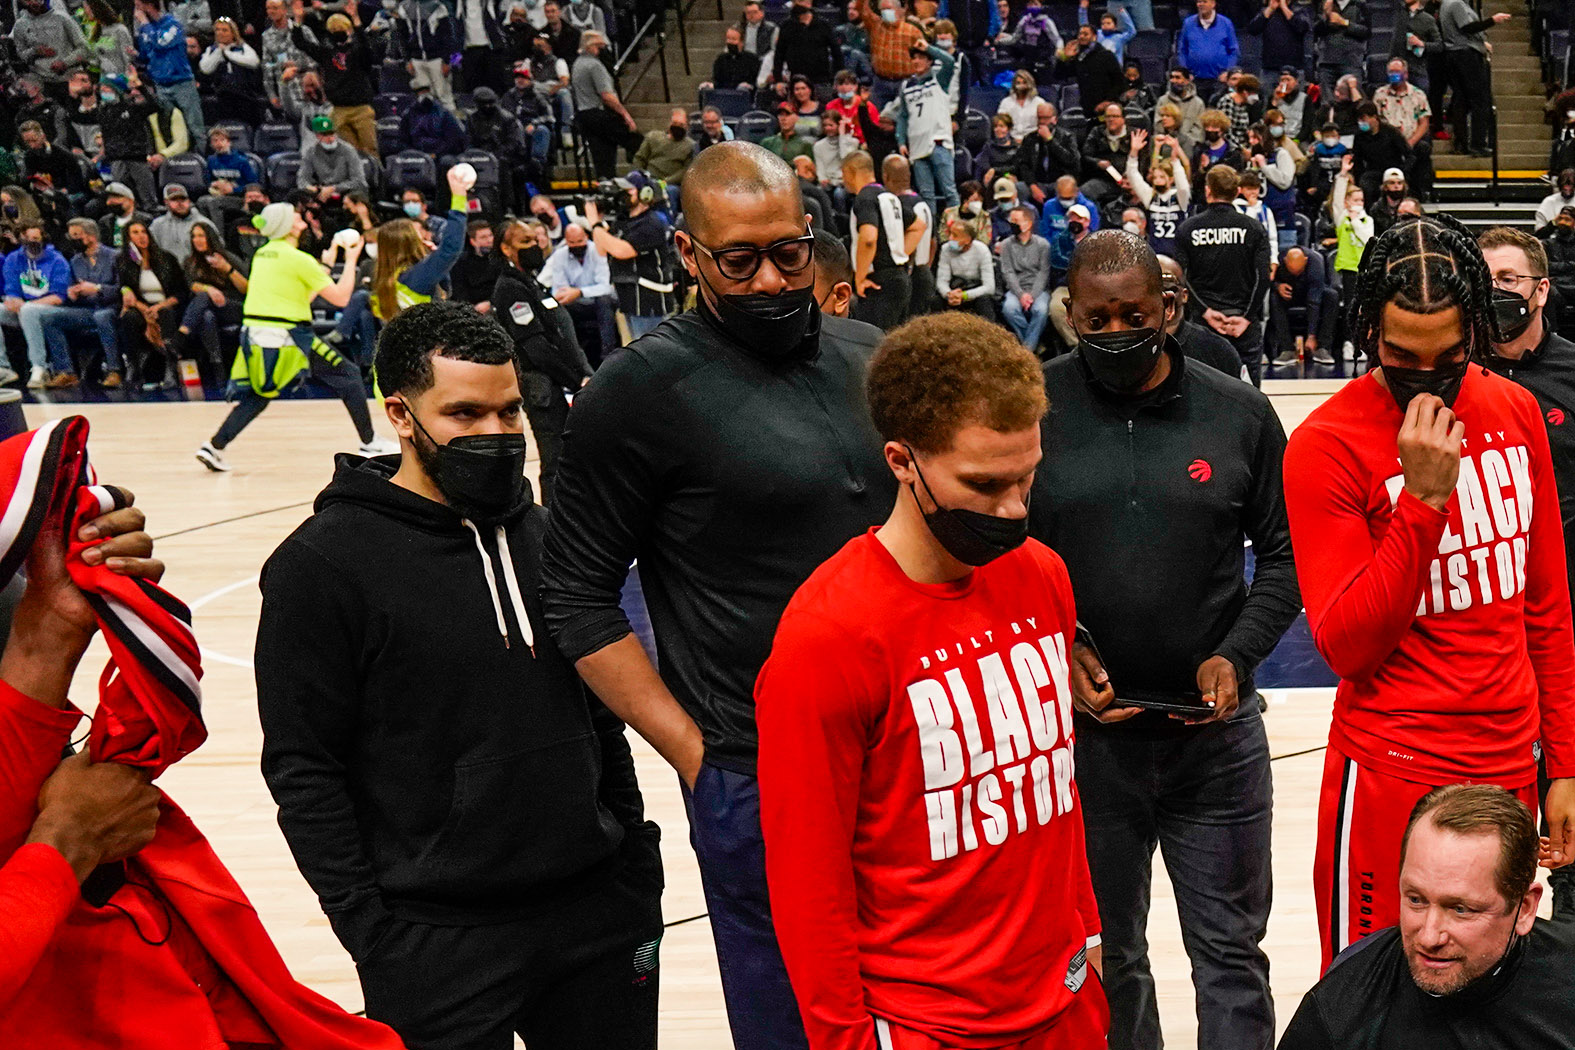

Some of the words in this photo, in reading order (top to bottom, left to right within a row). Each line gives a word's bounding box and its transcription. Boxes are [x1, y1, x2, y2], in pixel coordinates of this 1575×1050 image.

[1153, 221, 1176, 239] 32
[1191, 227, 1247, 247] SECURITY
[1484, 431, 1505, 443] BY
[1384, 445, 1534, 555] ACK
[1416, 534, 1530, 617] ISTOR
[920, 630, 994, 669] BUILT
[1010, 617, 1037, 635] BY
[906, 632, 1074, 790] BLACK
[1388, 750, 1413, 760] DRI-FIT
[1359, 872, 1374, 937] TORON
